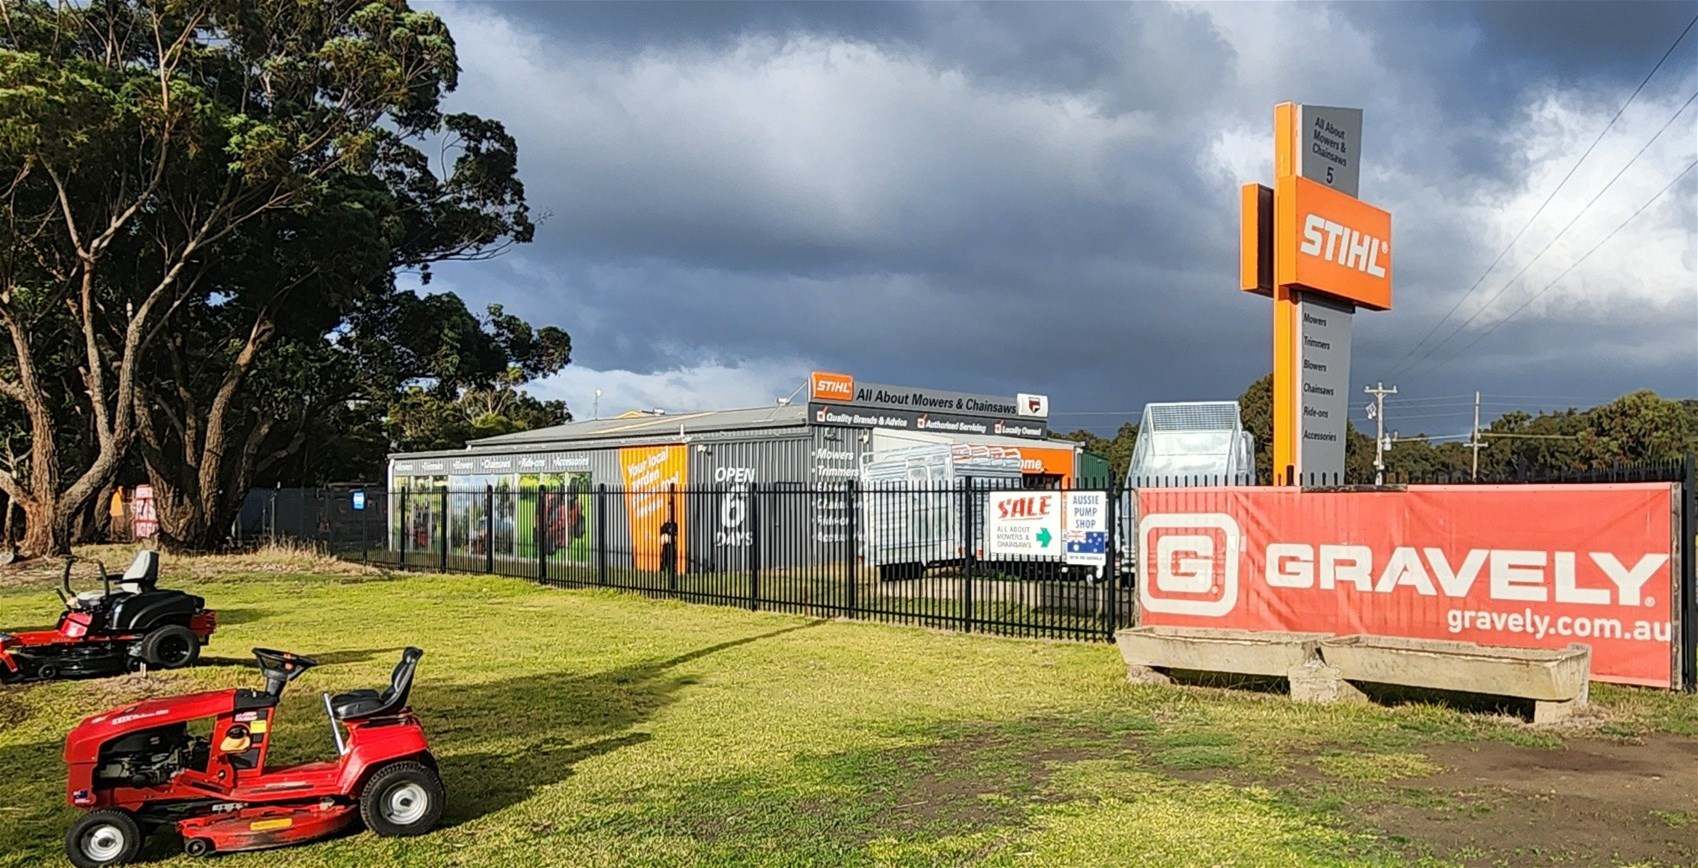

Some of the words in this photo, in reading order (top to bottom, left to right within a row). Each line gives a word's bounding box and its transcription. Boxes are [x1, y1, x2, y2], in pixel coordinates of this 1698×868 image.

[1314, 116, 1325, 130] All
[1325, 121, 1345, 140] About
[1313, 129, 1339, 150] Mowers
[1341, 142, 1346, 153] &
[1312, 142, 1347, 168] Chainsaws
[1326, 166, 1335, 184] 5
[1300, 213, 1386, 278] STIHL
[1303, 312, 1327, 327] Mowers
[1304, 336, 1331, 350] Trimmers
[1303, 359, 1327, 372] Blowers
[816, 380, 850, 394] STIHL
[1303, 382, 1334, 396] Chainsaws
[856, 388, 873, 401] All
[874, 390, 909, 405] About
[911, 393, 953, 409] Mowers
[955, 398, 963, 410] &
[965, 398, 1017, 414] Chainsaws
[1303, 406, 1329, 418] Ride-ons
[826, 412, 852, 424] Quality
[853, 414, 878, 425] Brands
[878, 416, 884, 425] &
[885, 416, 908, 427] Advice
[959, 421, 987, 434] Servicing
[1002, 425, 1021, 436] Locally
[1021, 426, 1041, 436] Owned
[1303, 430, 1337, 442] Accessories
[817, 447, 854, 460] Mowers
[715, 467, 755, 483] OPEN
[817, 464, 859, 477] Trimmers
[997, 495, 1052, 518] SALE
[1072, 495, 1099, 505] AUSSIE
[1074, 507, 1098, 517] PUMP
[1075, 519, 1096, 529] SHOP
[716, 531, 753, 546] DAYS
[997, 533, 1023, 541] MOWERS
[1265, 543, 1670, 607] GRAVELY
[1447, 608, 1671, 642] gravely.com.au
